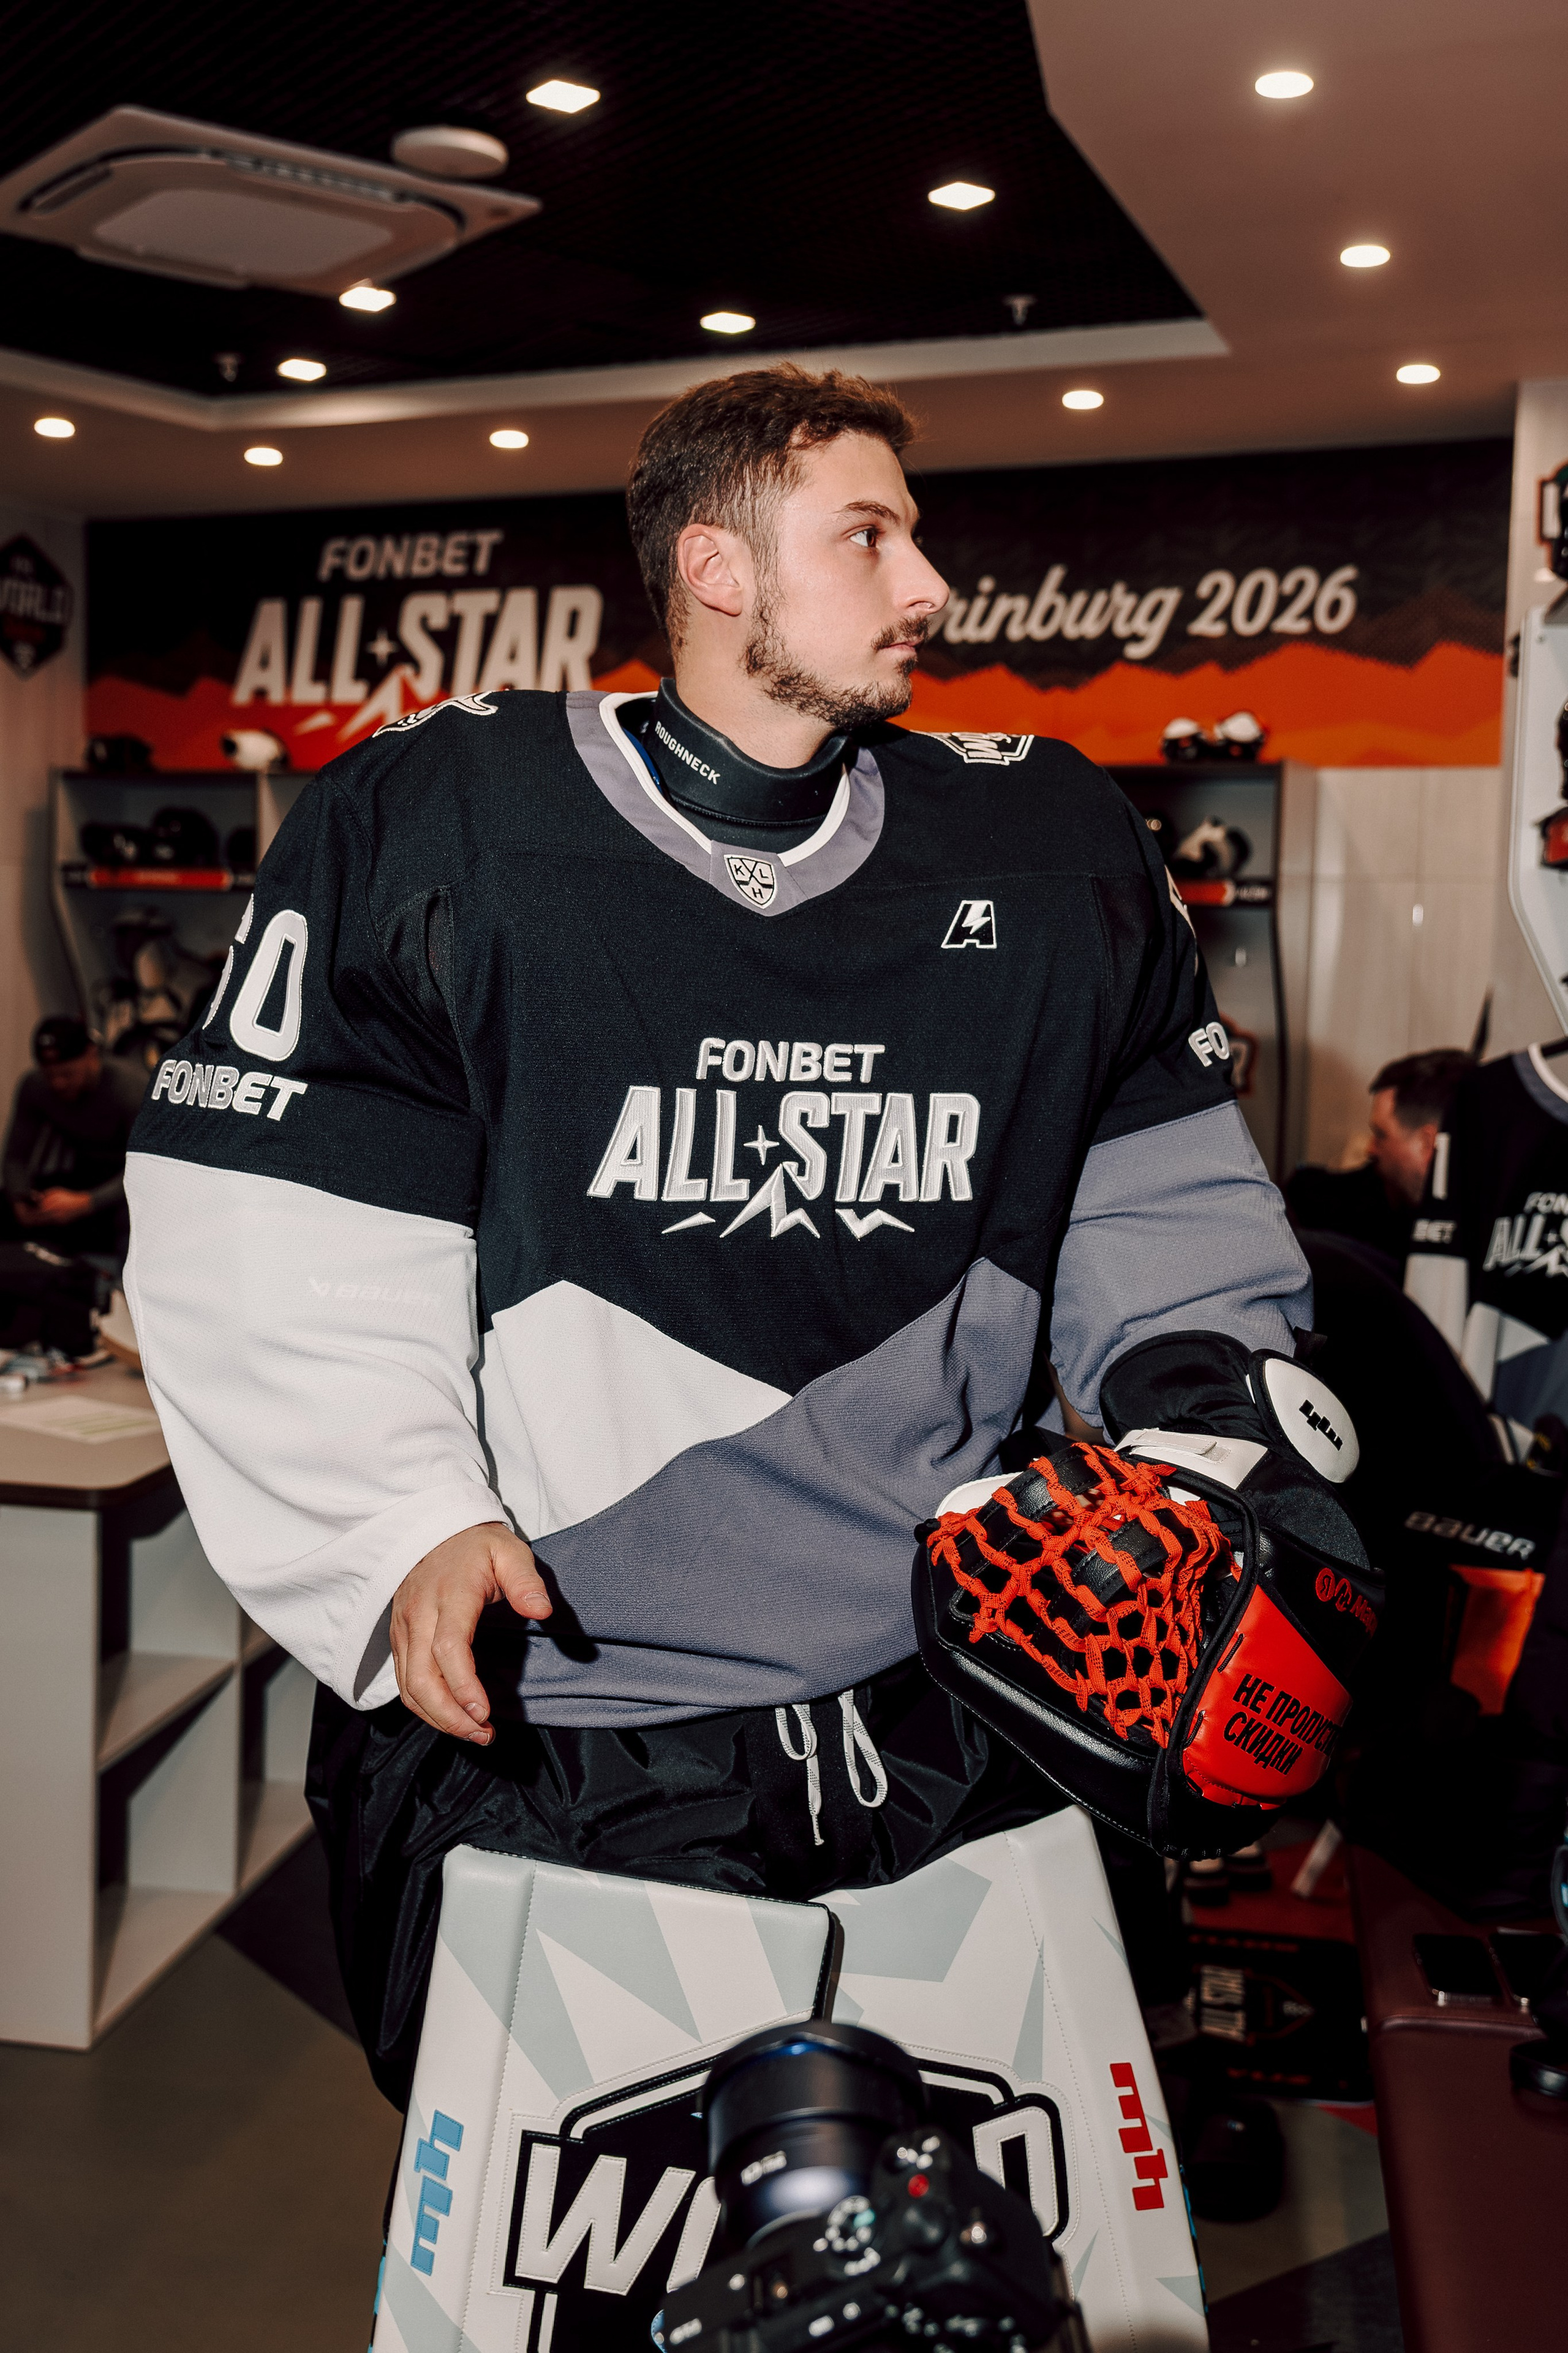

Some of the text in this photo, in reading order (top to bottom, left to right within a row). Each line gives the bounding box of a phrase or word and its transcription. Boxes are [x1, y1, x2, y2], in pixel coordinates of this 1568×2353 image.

[318, 529, 503, 581] FONBET
[1188, 564, 1359, 637] 2026
[232, 585, 603, 706] ALL STAR
[655, 721, 721, 785] ROUGHNECK
[151, 1059, 307, 1121] FONBET
[696, 1038, 886, 1083] FONBET
[587, 1086, 981, 1201] ALL STAR
[1232, 1673, 1275, 1714] НЕ
[1223, 1712, 1303, 1775] СКИДКИ
